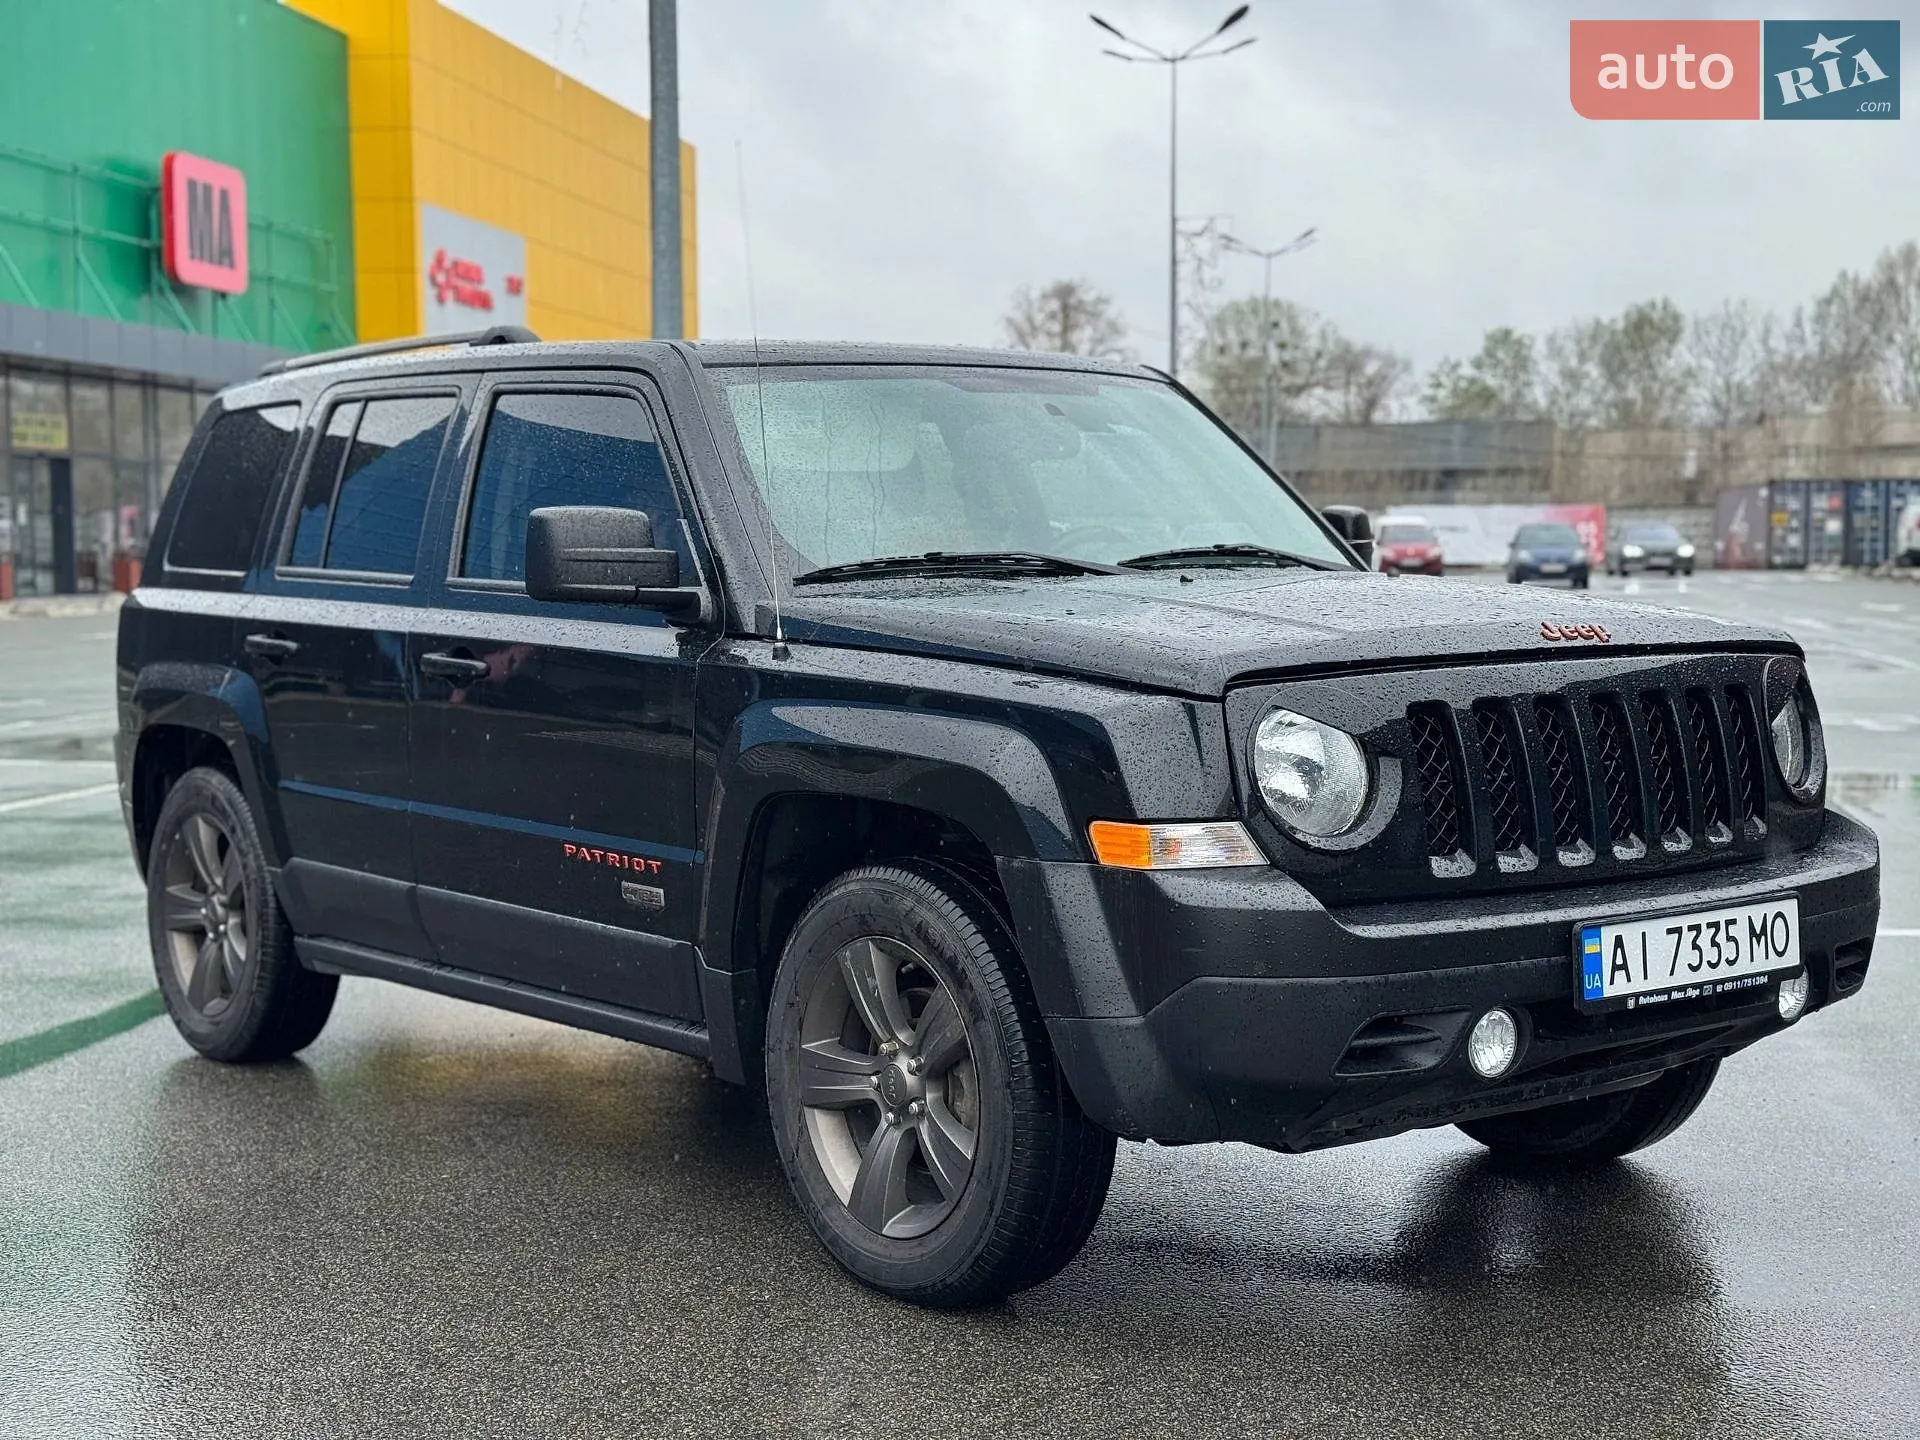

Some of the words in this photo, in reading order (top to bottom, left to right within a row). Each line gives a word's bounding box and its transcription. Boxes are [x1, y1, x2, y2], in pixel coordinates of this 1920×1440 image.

[1540, 621, 1611, 643] Jeep
[563, 843, 662, 875] PATRIOT
[1609, 931, 1649, 986] AI
[1665, 918, 1740, 977] 7335
[1747, 910, 1790, 963] MO
[1584, 973, 1602, 990] UA
